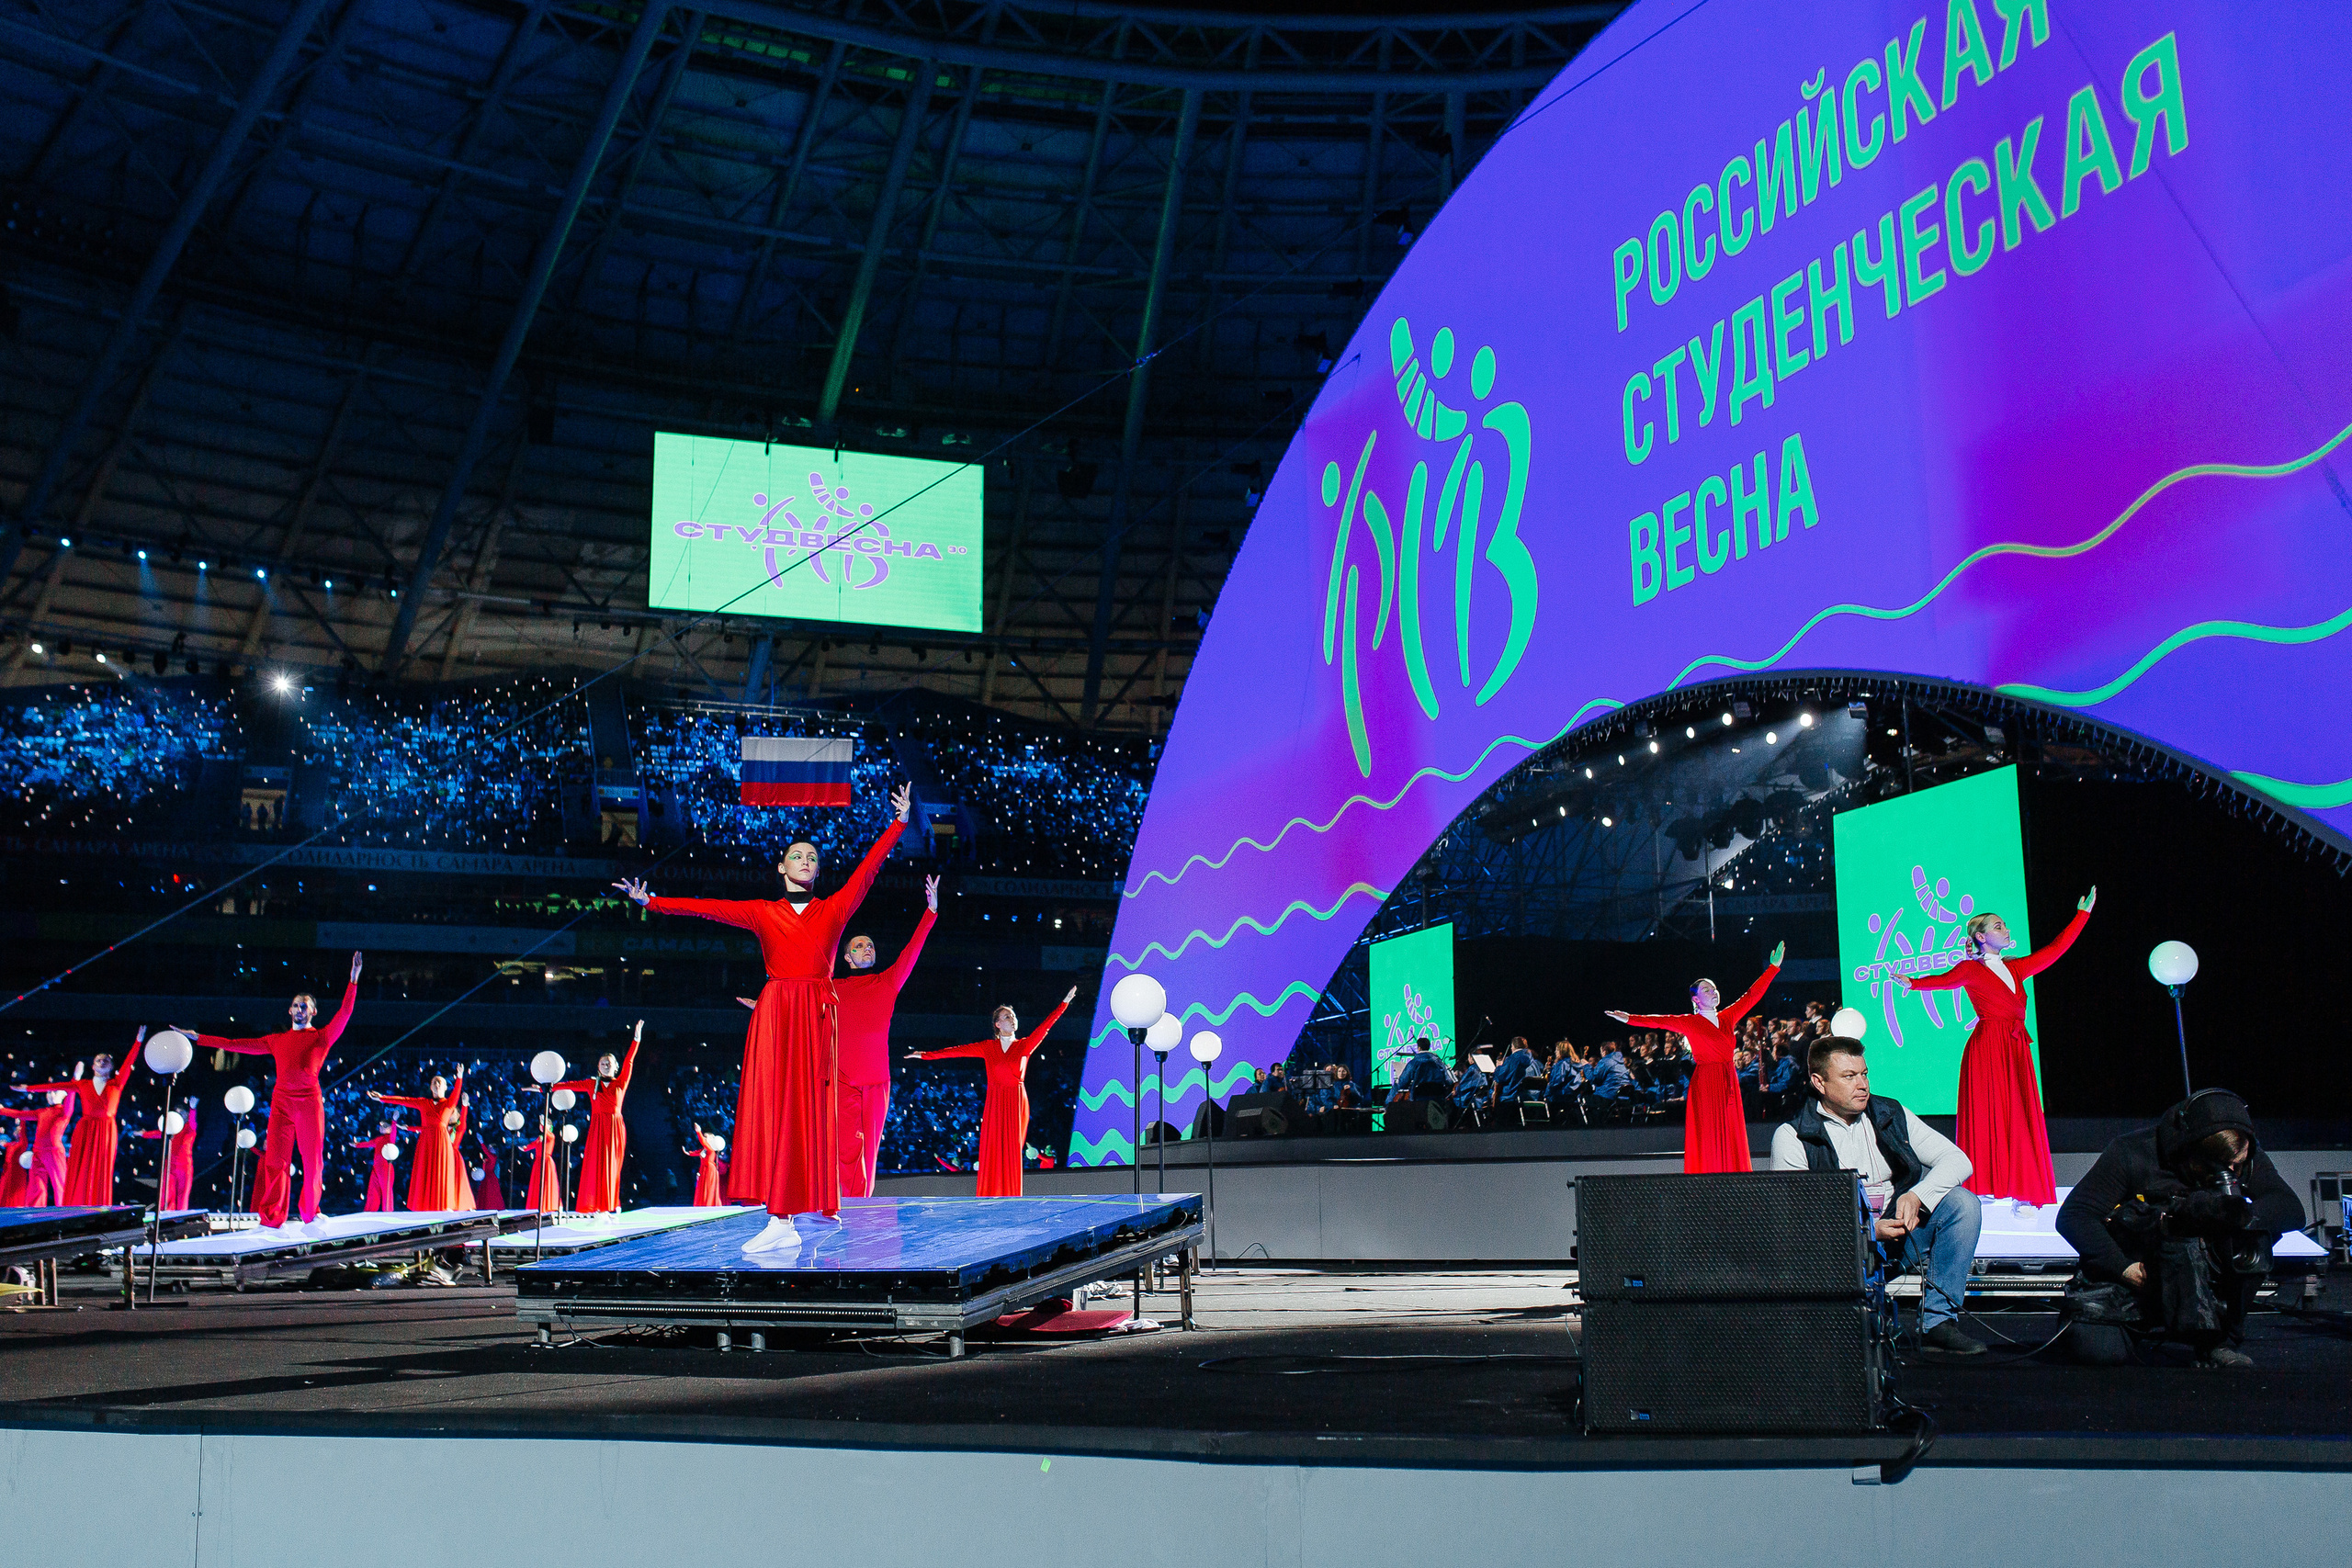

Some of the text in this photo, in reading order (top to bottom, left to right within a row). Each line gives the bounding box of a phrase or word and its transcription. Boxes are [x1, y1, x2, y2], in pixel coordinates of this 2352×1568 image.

[1622, 30, 2189, 466] СТУДЕНЧЕСКАЯ
[1629, 432, 1819, 607] ВЕСНА
[673, 520, 967, 561] СТУДВЕСНА 30
[652, 865, 775, 884] СОЛИДАРНОС
[994, 880, 1110, 897] СОЛИДАРНОСТ
[622, 937, 728, 953] САМАРА
[1854, 951, 1973, 982] СТУДВЕС
